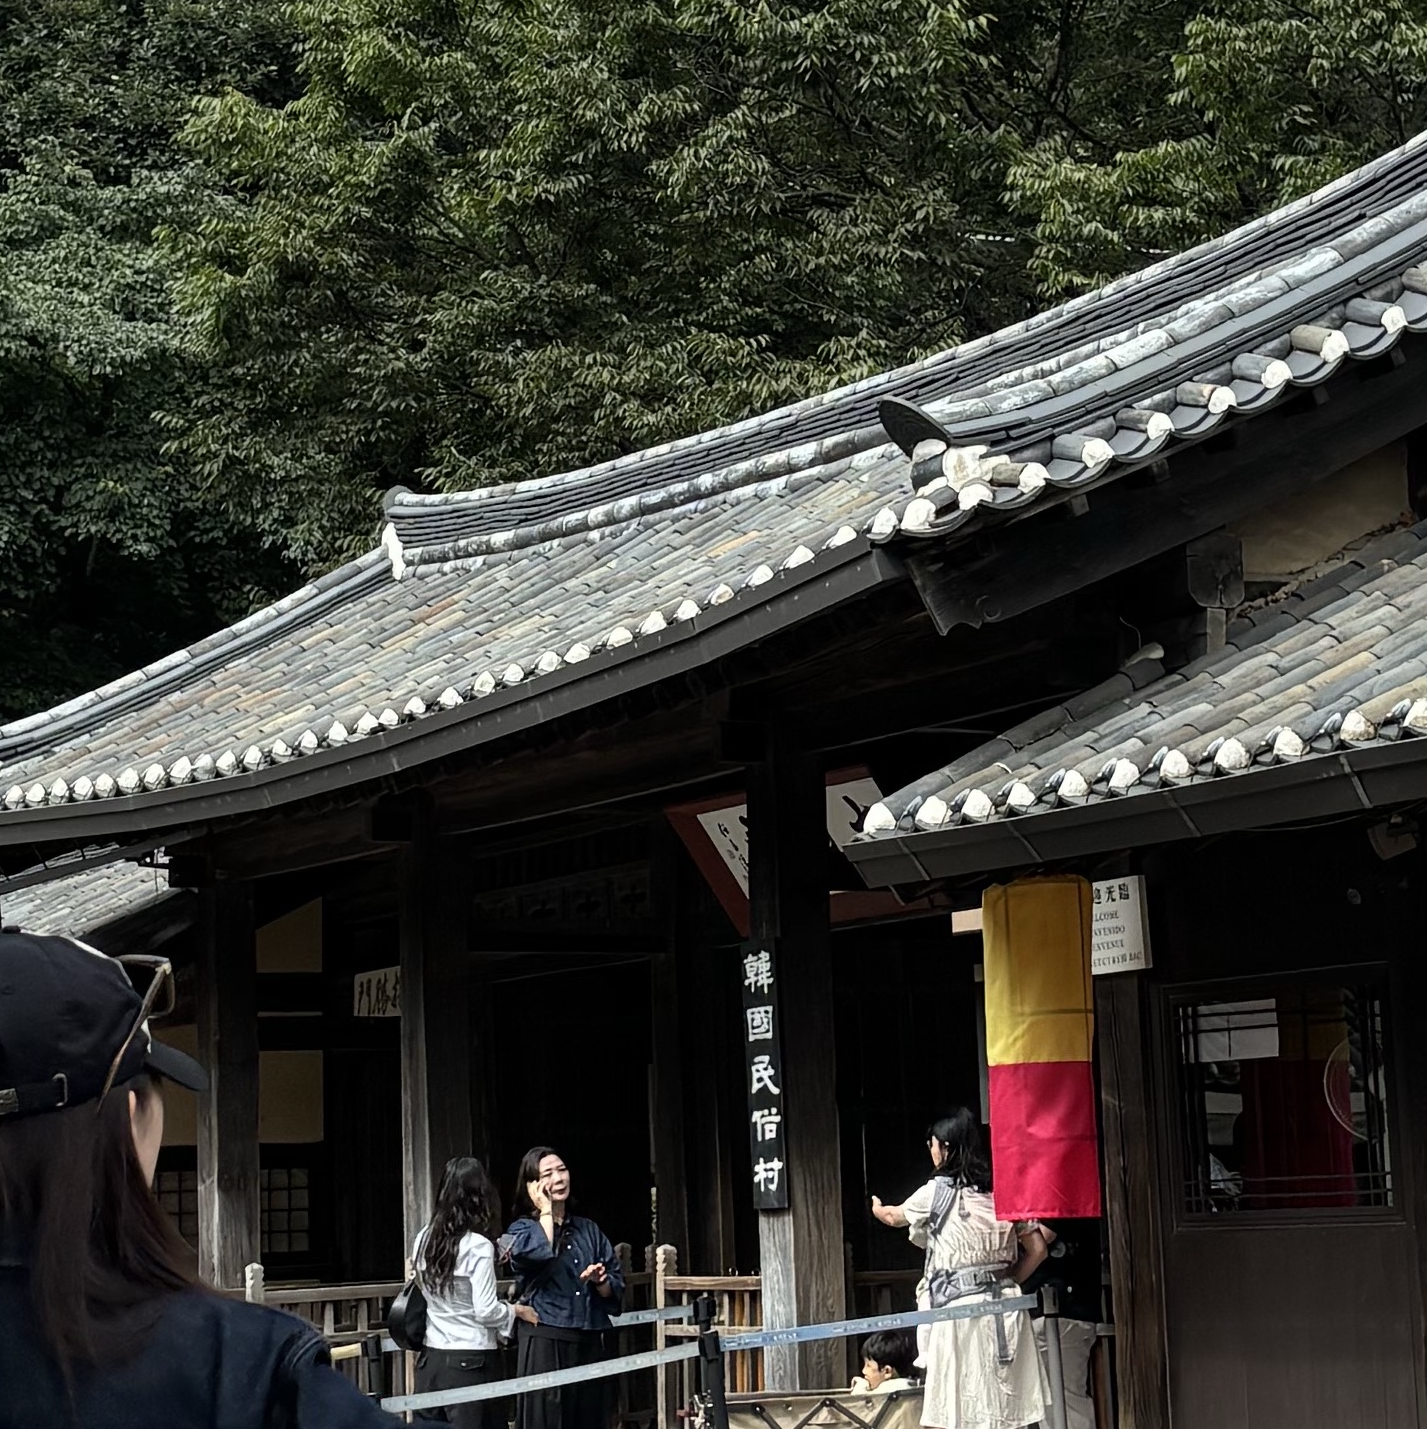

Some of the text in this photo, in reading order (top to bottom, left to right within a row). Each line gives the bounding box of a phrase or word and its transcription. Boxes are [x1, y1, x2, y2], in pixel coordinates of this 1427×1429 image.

[743, 950, 784, 1193] 韓國民俗村
